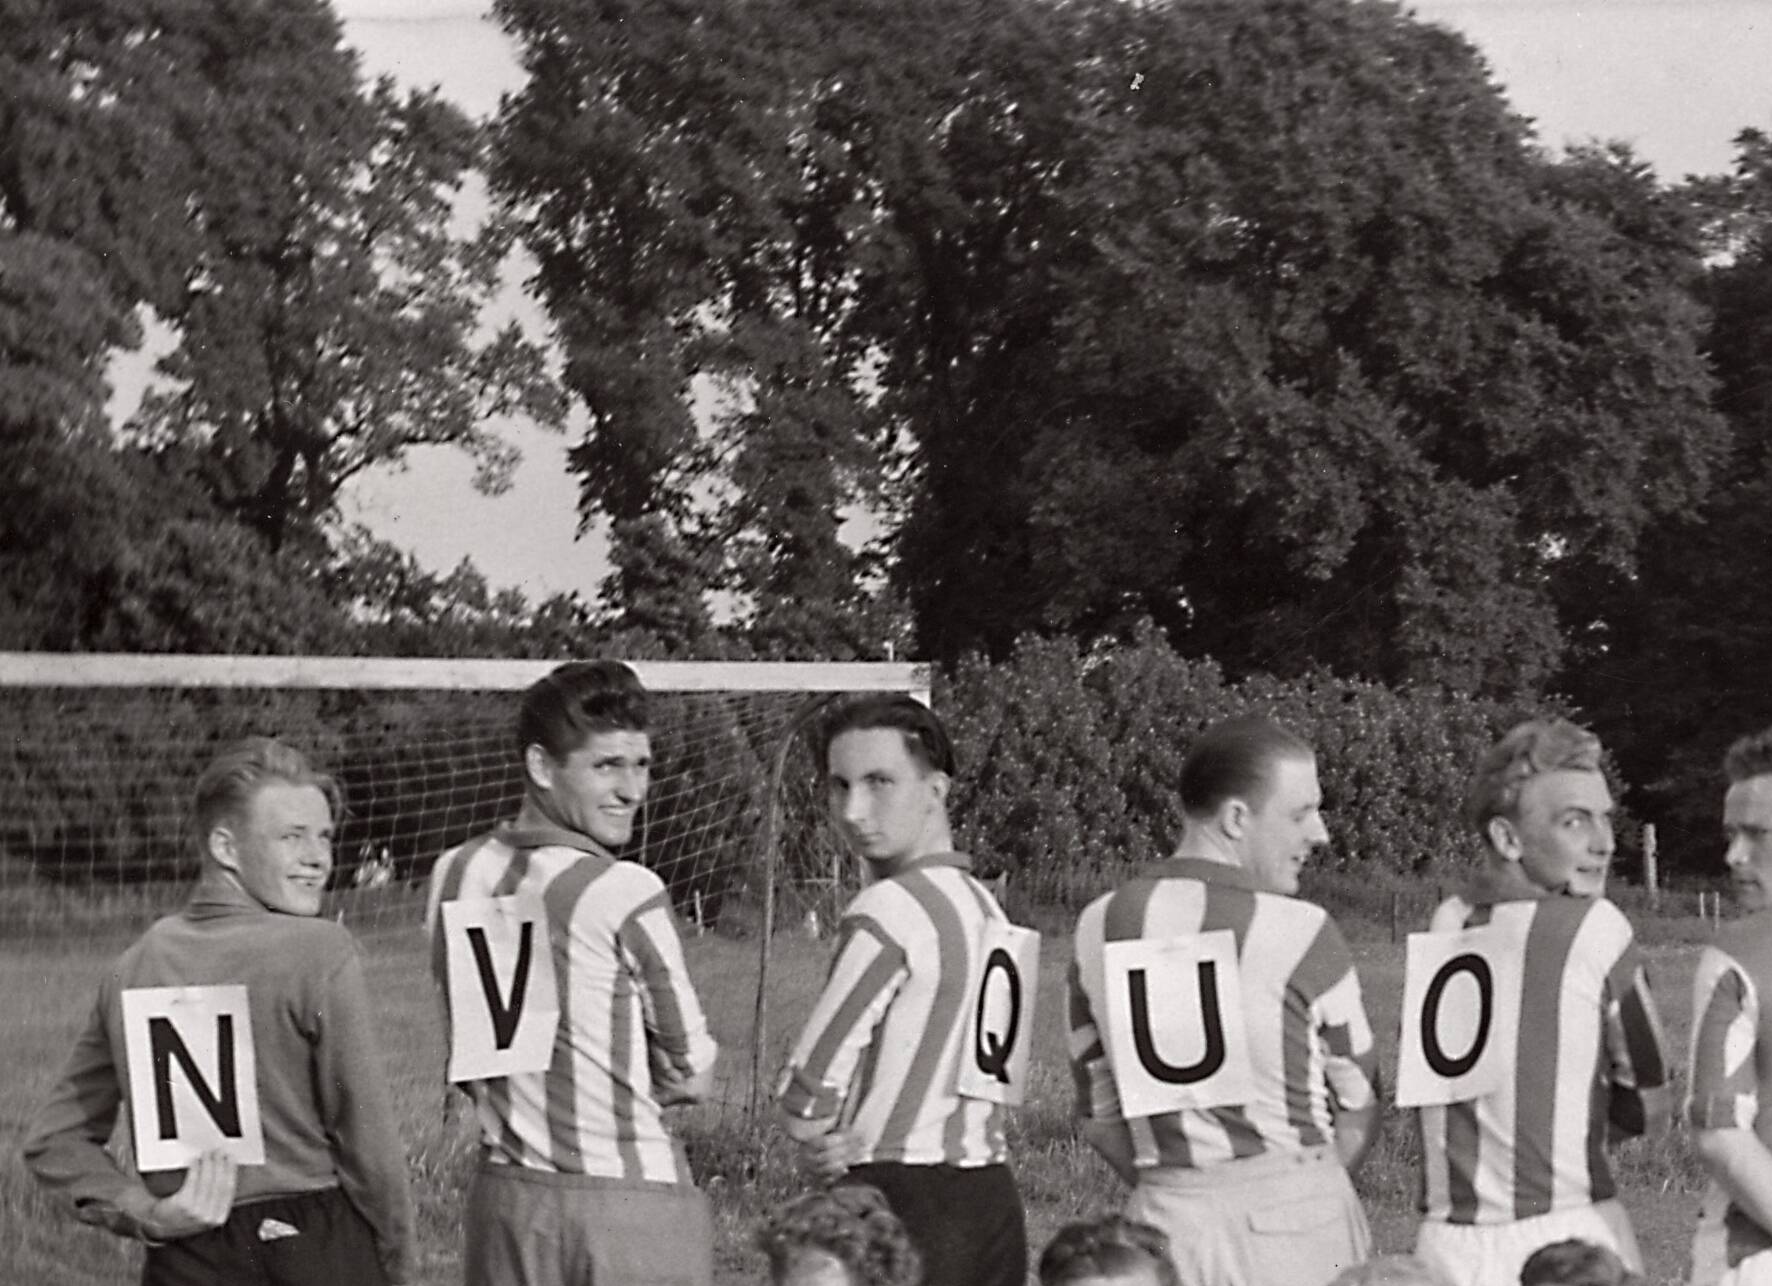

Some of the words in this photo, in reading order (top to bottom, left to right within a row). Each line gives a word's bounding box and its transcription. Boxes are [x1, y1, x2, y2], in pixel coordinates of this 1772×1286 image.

[466, 922, 533, 1050] V
[976, 949, 1021, 1084] Q
[1128, 961, 1225, 1084] U
[1421, 954, 1492, 1077] O
[149, 1015, 242, 1140] N
